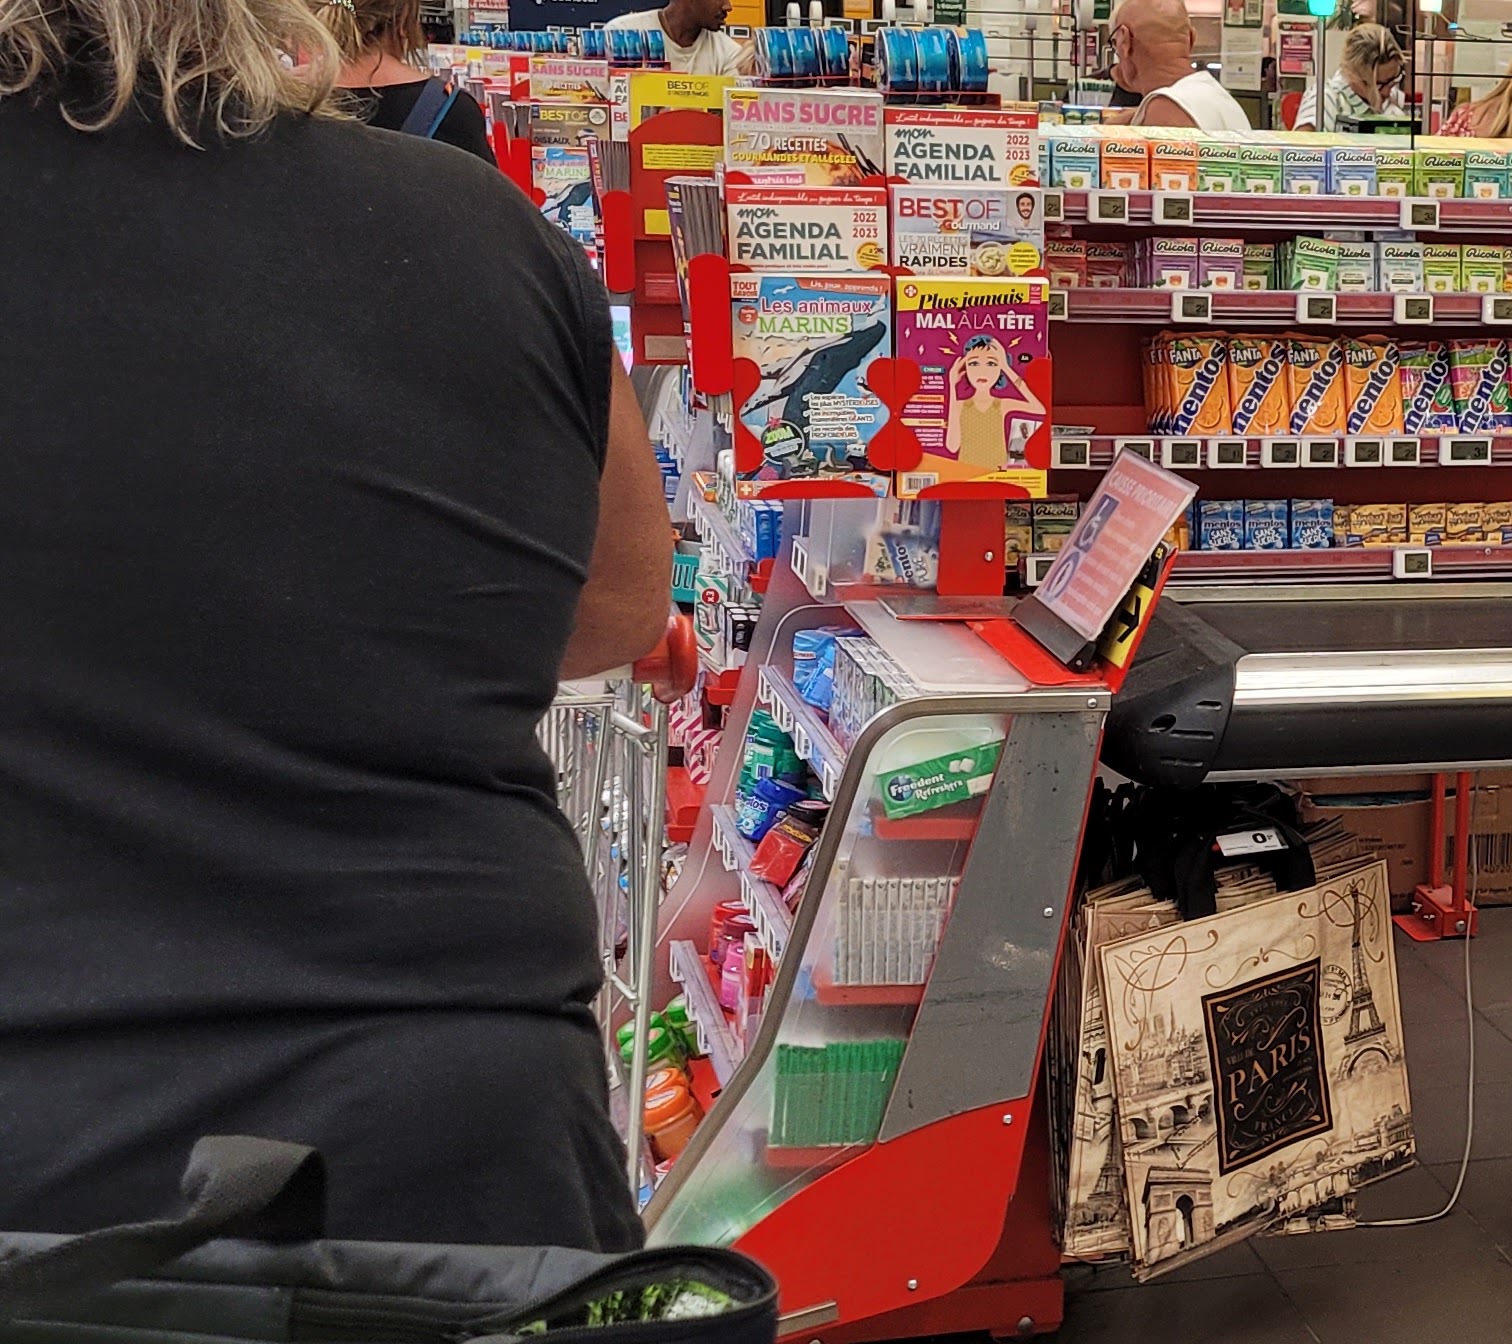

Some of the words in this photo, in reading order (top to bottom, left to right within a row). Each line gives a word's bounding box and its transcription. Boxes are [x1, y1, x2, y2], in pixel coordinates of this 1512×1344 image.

[667, 80, 693, 90] BEST
[540, 109, 570, 121] BEST
[730, 100, 795, 123] SANS
[799, 102, 877, 126] SUCRE
[774, 137, 828, 152] RECETTES
[1006, 135, 1030, 145] 2022
[893, 142, 995, 161] AGENDA
[1005, 150, 1031, 160] 2023
[1056, 142, 1095, 155] Ricola
[1105, 143, 1144, 156] Ricola
[1156, 143, 1194, 157] Ricola
[1199, 147, 1237, 160] Ricola
[894, 162, 1002, 181] FAMILIAL
[899, 197, 964, 219] BEST
[966, 199, 1002, 219] OF
[852, 212, 878, 223] 2022
[736, 221, 842, 240] AGENDA
[852, 227, 878, 239] 2023
[737, 242, 849, 261] FAMILIAL
[899, 243, 967, 256] VRAIMENT
[899, 256, 968, 268] RAPIDES
[732, 281, 758, 292] TOUT
[760, 297, 795, 314] Les
[798, 297, 874, 314] animaux
[918, 294, 959, 310] Plus
[956, 289, 1024, 313] jamais
[758, 316, 849, 335] MARINS
[916, 312, 956, 329] MAL
[957, 310, 972, 330] À
[973, 313, 996, 330] LA
[997, 310, 1035, 330] TÊTE
[1169, 347, 1202, 363] FANTA
[1229, 347, 1263, 363] FANTA
[1287, 346, 1320, 363] FANTA
[1344, 346, 1377, 363] FANTA
[1173, 340, 1228, 435] mentos
[1232, 340, 1288, 435] mentos
[1290, 340, 1343, 435] mentos
[1347, 340, 1400, 435] mentos
[890, 773, 945, 797] Freedent
[1227, 1026, 1311, 1105] PARIS
